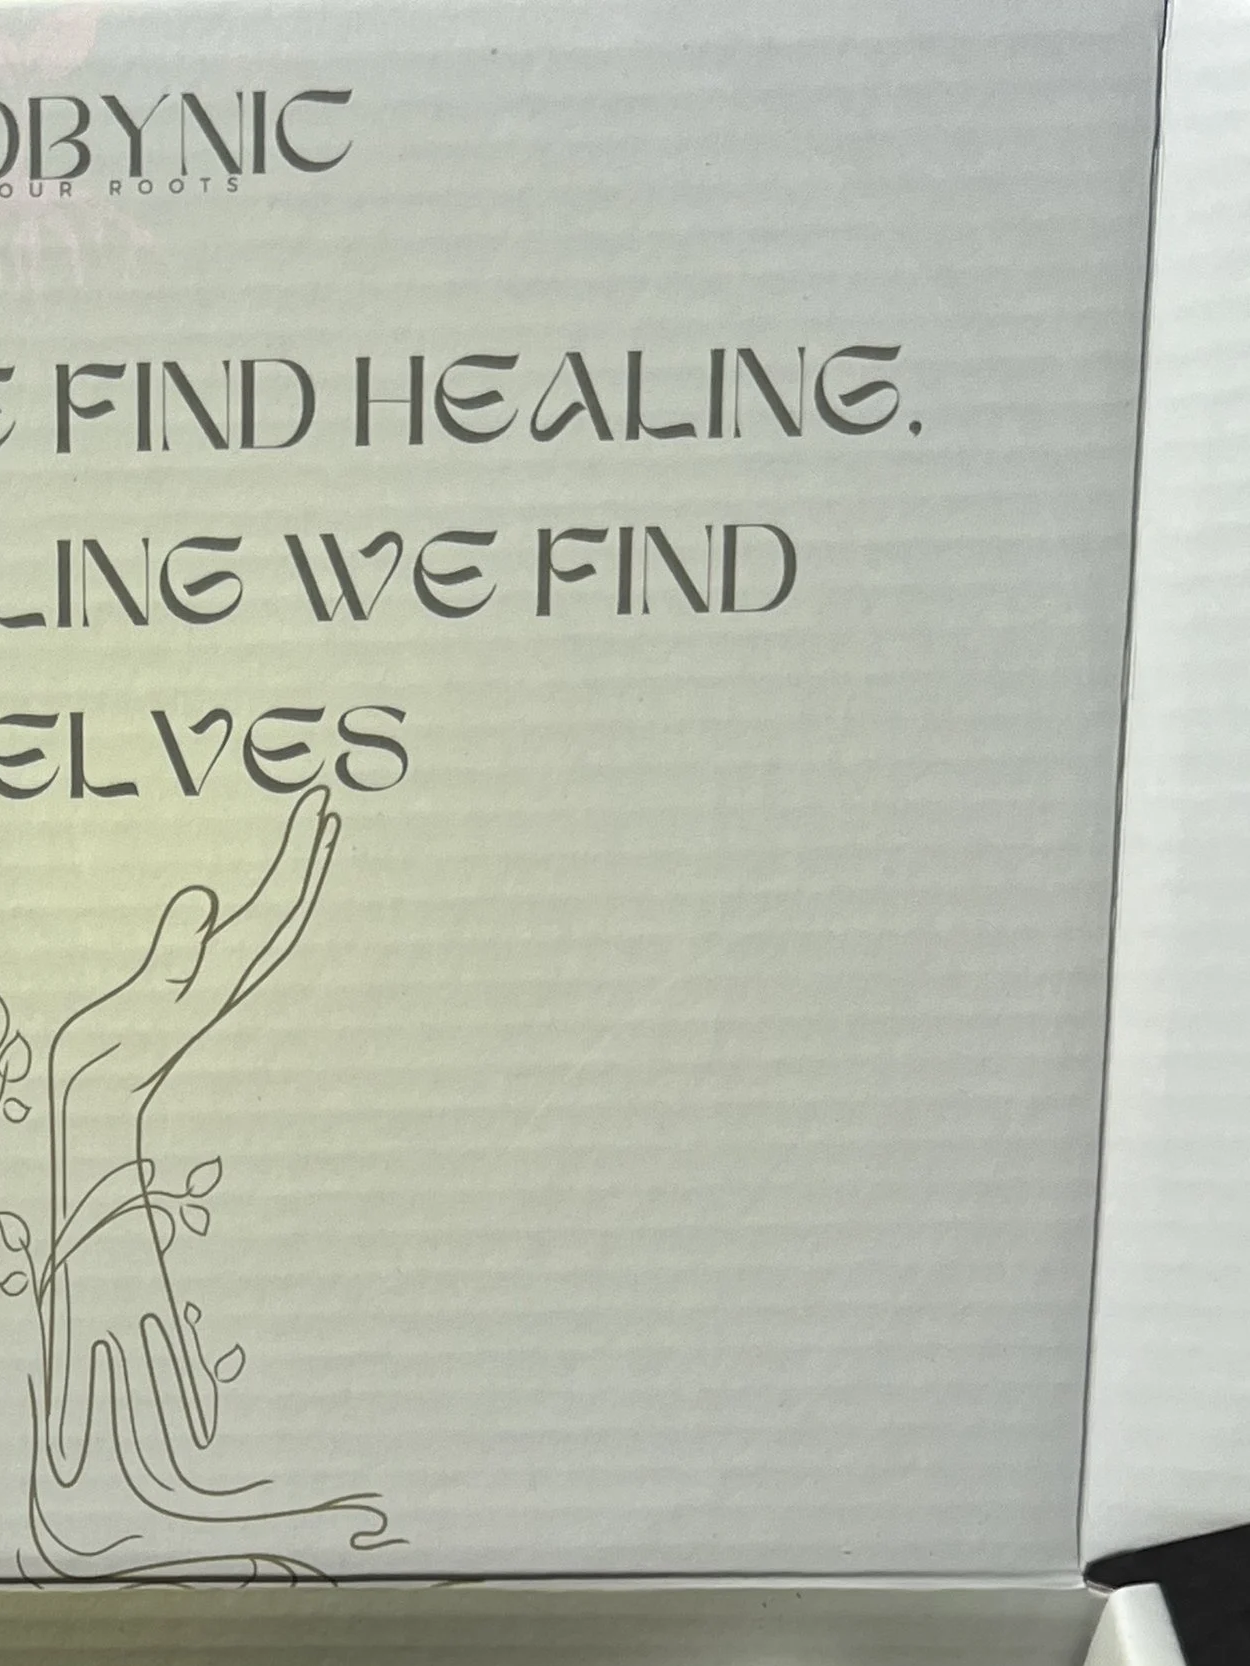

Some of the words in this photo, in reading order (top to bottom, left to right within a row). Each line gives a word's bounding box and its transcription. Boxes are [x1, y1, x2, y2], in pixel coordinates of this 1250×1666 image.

[110, 176, 240, 196] ROOTS
[55, 358, 316, 453] FIND
[355, 344, 923, 446] HEALING.
[283, 529, 498, 622] WE
[536, 523, 798, 616] FIND
